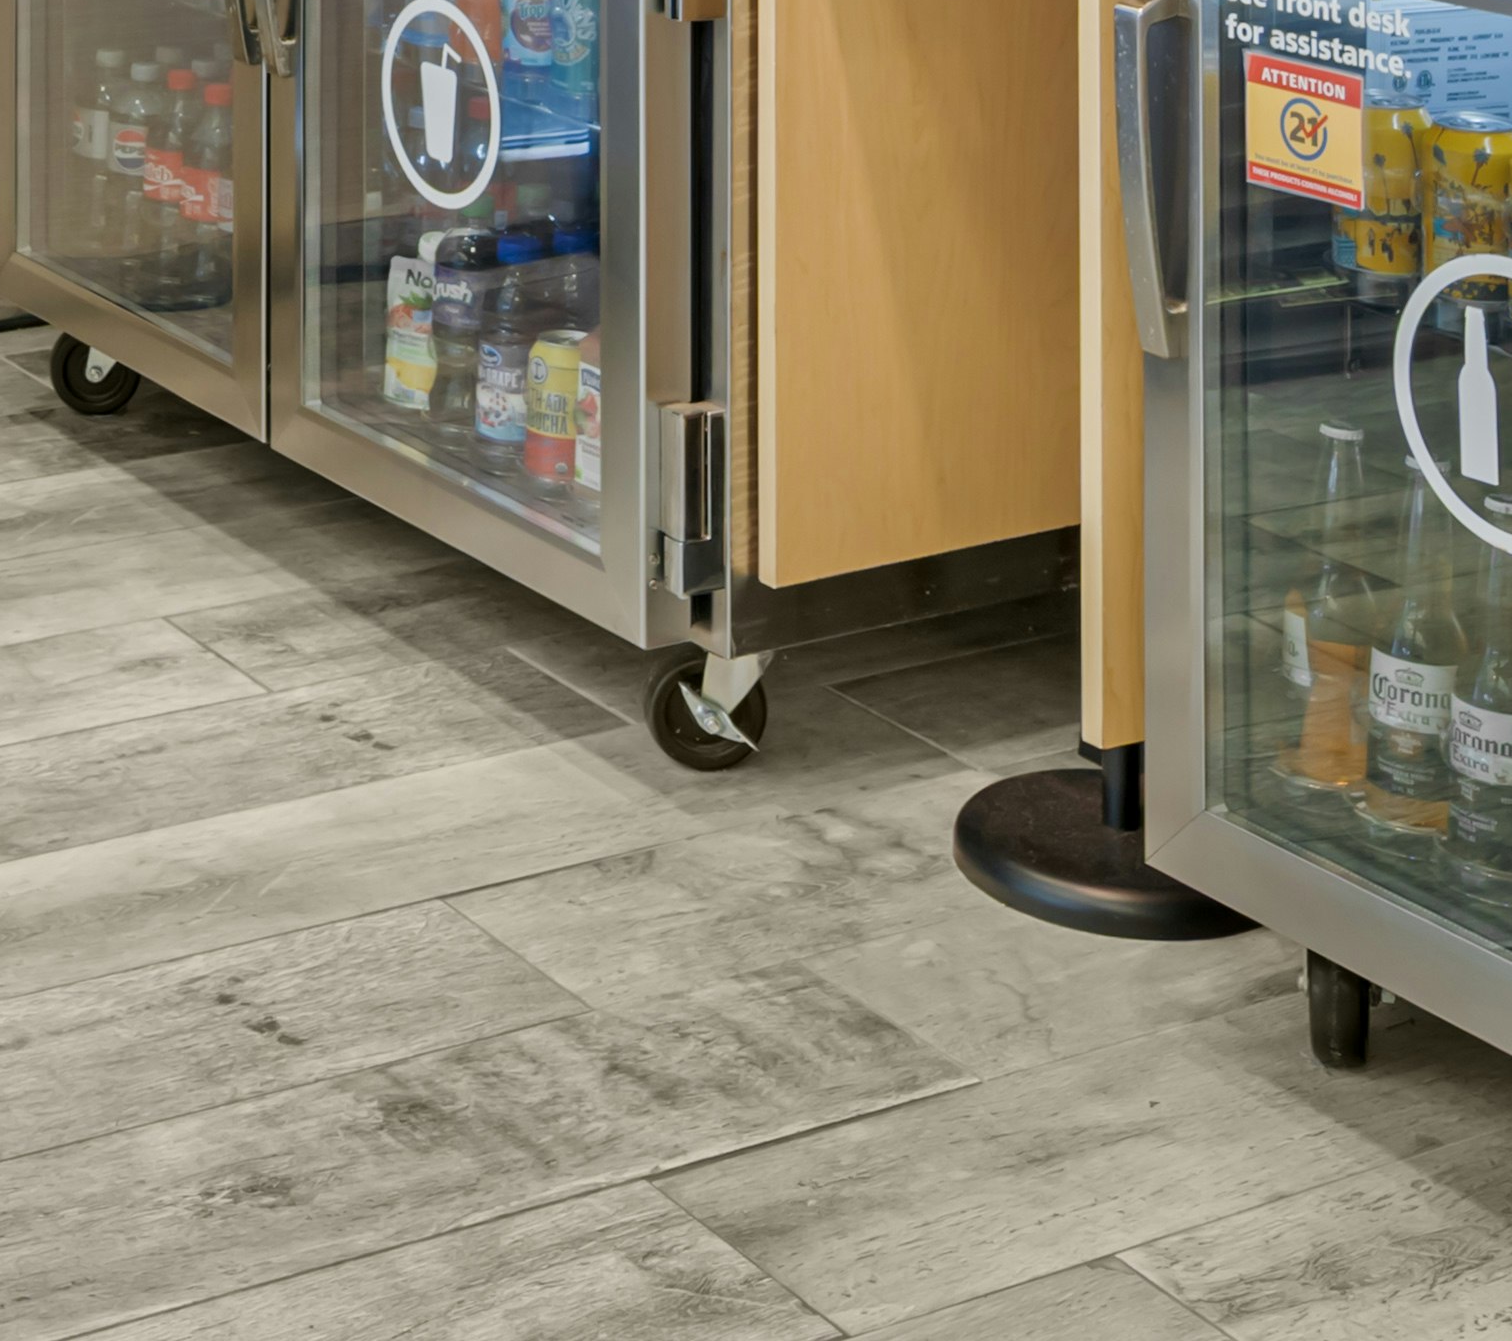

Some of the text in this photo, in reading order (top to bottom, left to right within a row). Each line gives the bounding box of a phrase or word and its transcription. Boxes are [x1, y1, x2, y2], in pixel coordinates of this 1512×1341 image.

[1349, 1, 1411, 38] desk
[1226, 13, 1264, 43] for
[1270, 29, 1412, 79] assistance.
[1261, 67, 1346, 101] ATTENTION
